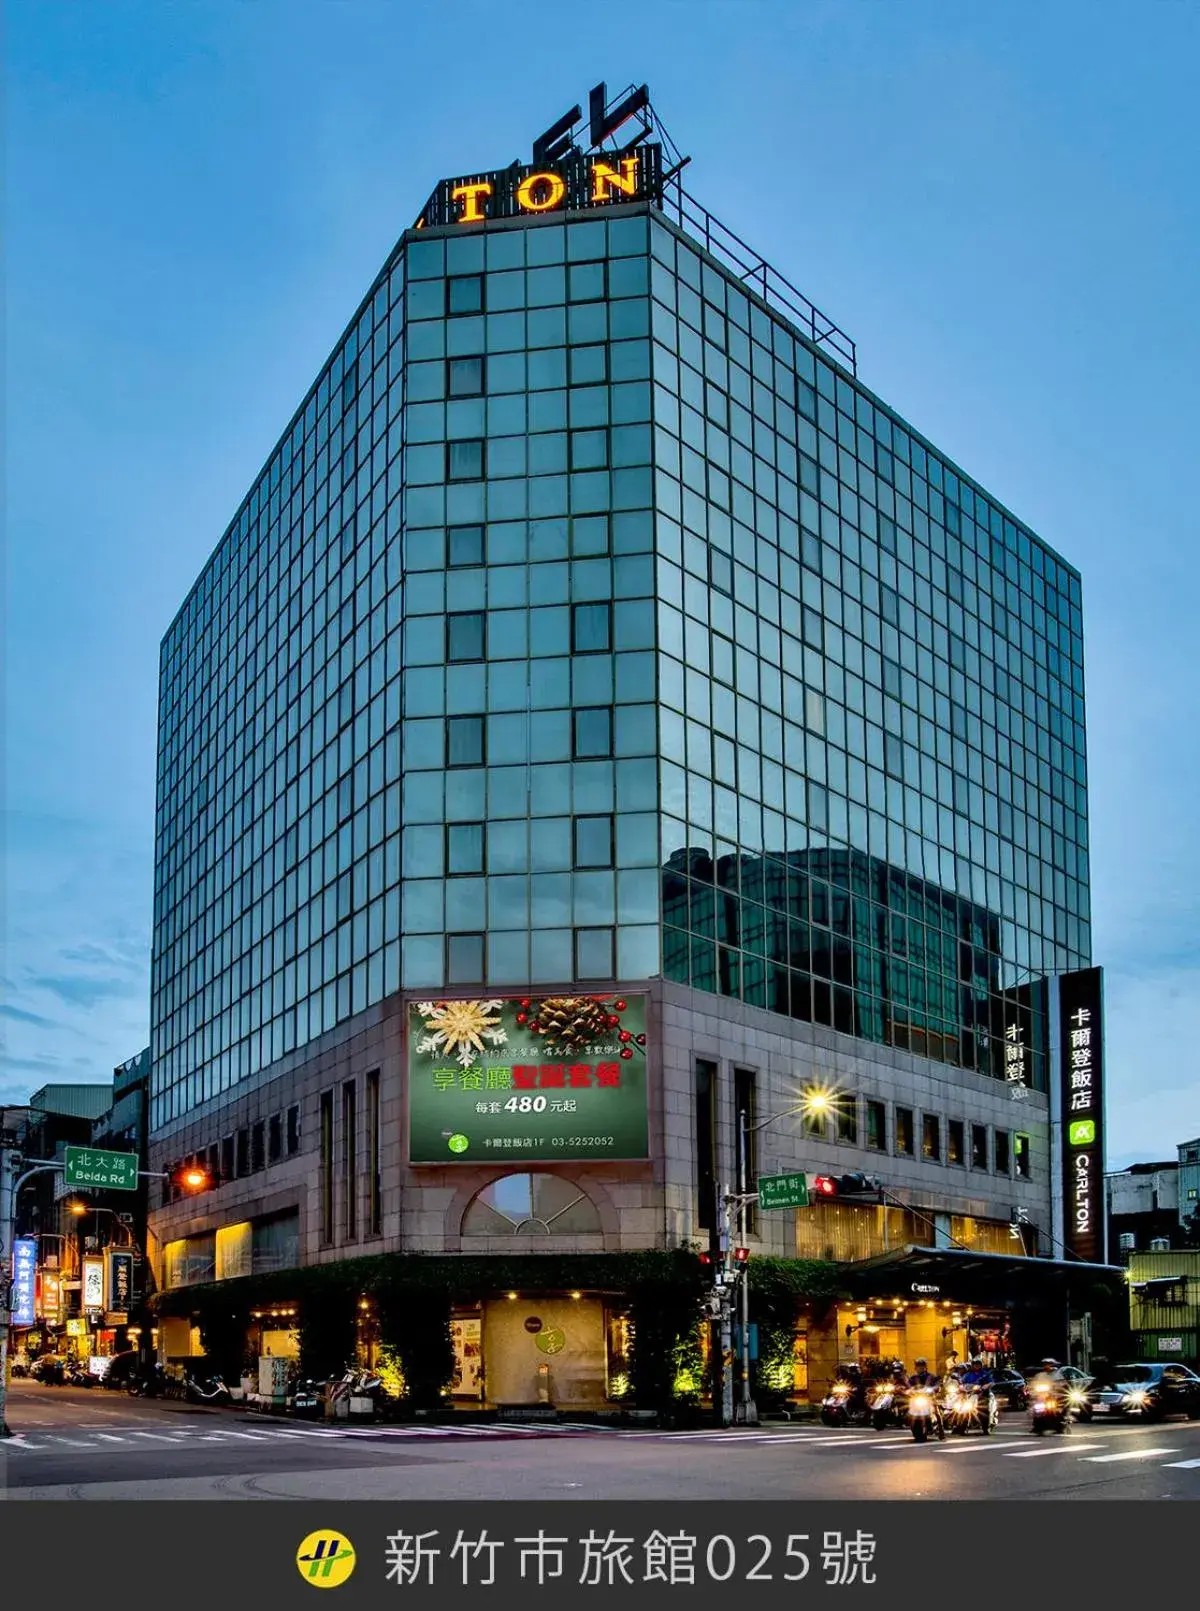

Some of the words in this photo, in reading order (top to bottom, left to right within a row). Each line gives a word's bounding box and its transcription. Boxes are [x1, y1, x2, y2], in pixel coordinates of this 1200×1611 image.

[451, 157, 641, 223] TON
[1070, 1008, 1092, 1110] 卡爾登飯店
[475, 1100, 503, 1114] 每套
[504, 1096, 547, 1114] 480
[550, 1100, 577, 1113] 元起
[77, 1152, 126, 1170] 北大路
[75, 1171, 108, 1183] Beida
[110, 1173, 125, 1184] Rd
[765, 1178, 798, 1192] 北門街
[1076, 1154, 1090, 1233] CARLTON
